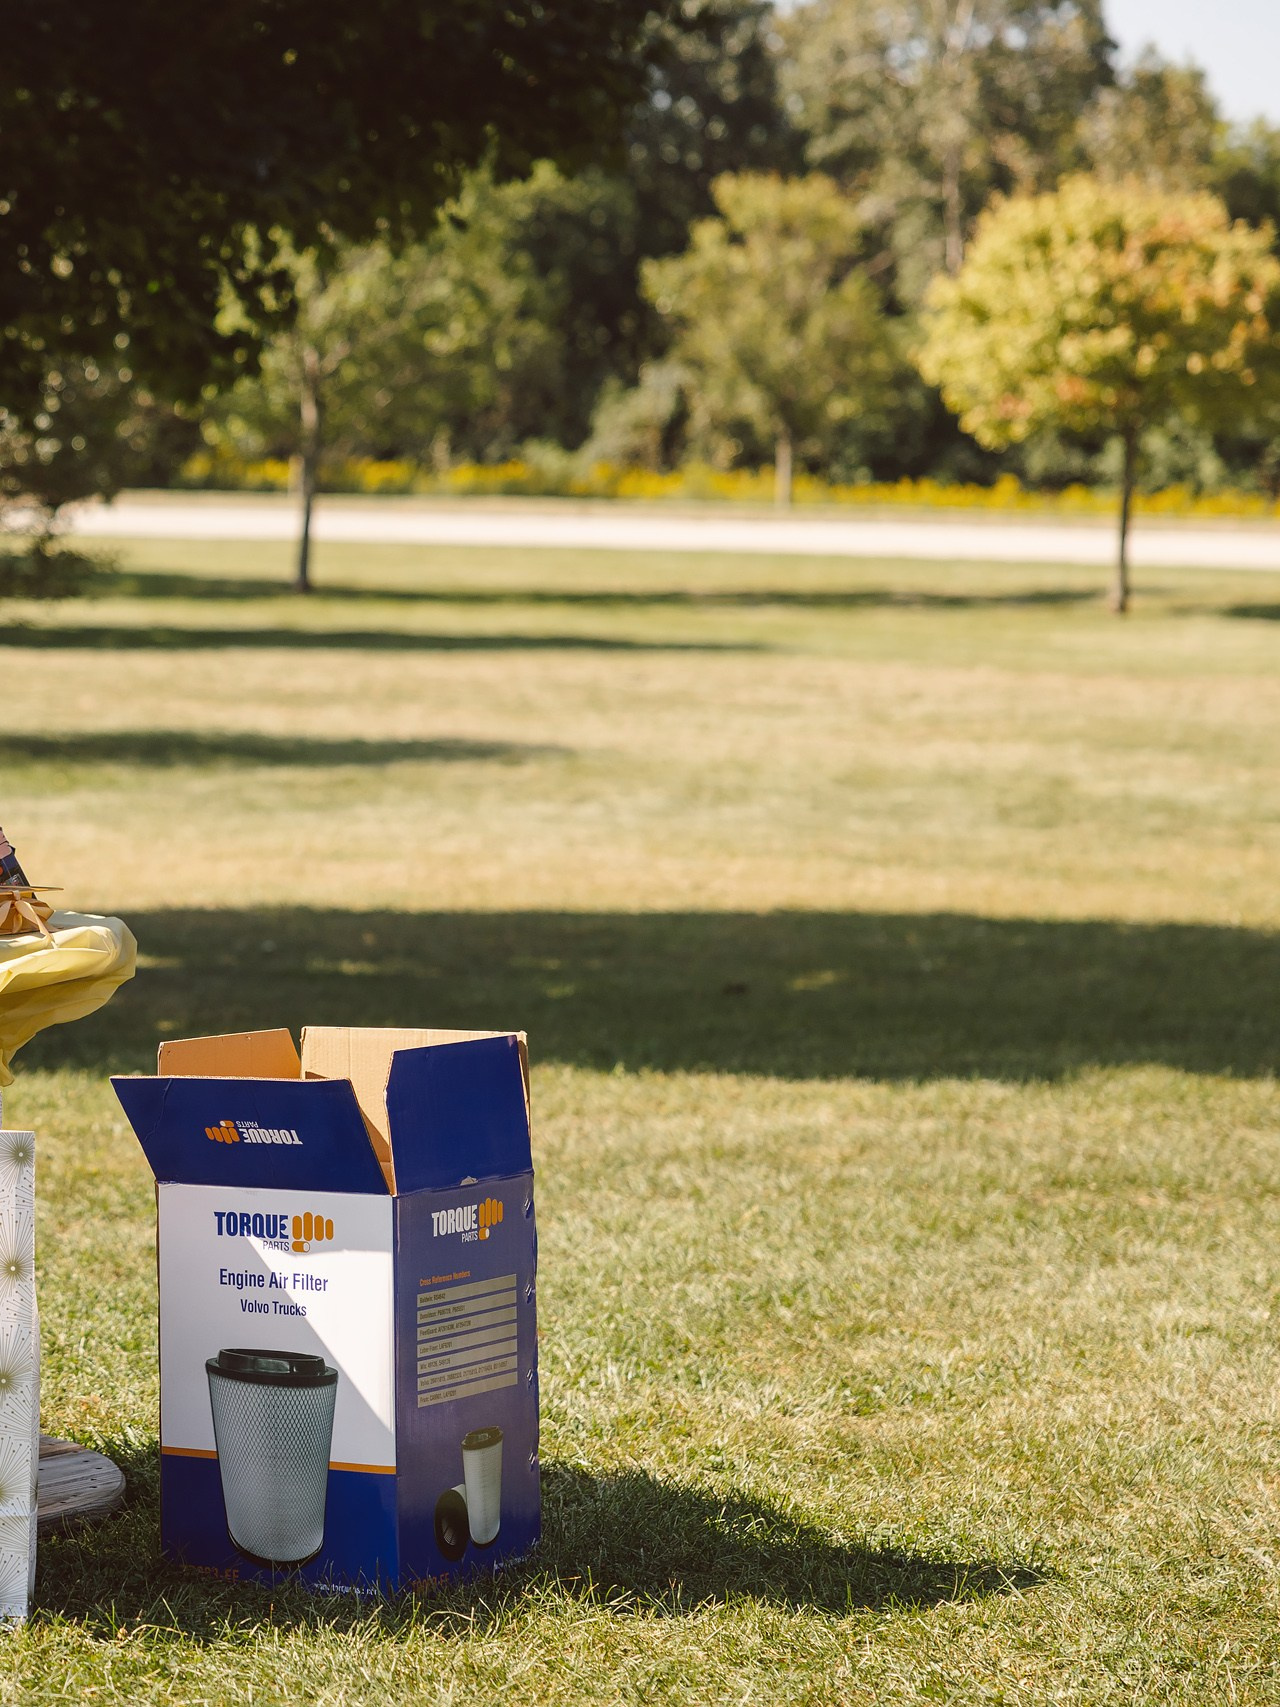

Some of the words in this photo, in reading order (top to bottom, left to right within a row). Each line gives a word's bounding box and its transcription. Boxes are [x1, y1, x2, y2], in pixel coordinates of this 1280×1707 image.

[235, 1120, 259, 1128] PARTS
[238, 1128, 304, 1145] TORQUE
[213, 1211, 289, 1239] TORQUE
[431, 1204, 478, 1237] TORQUE
[262, 1240, 290, 1251] PARTS
[461, 1230, 478, 1243] PARTS
[219, 1268, 265, 1290] Engine
[268, 1271, 289, 1289] Air
[292, 1273, 328, 1291] Filter
[240, 1298, 269, 1314] Volvo
[272, 1301, 307, 1317] Trucks
